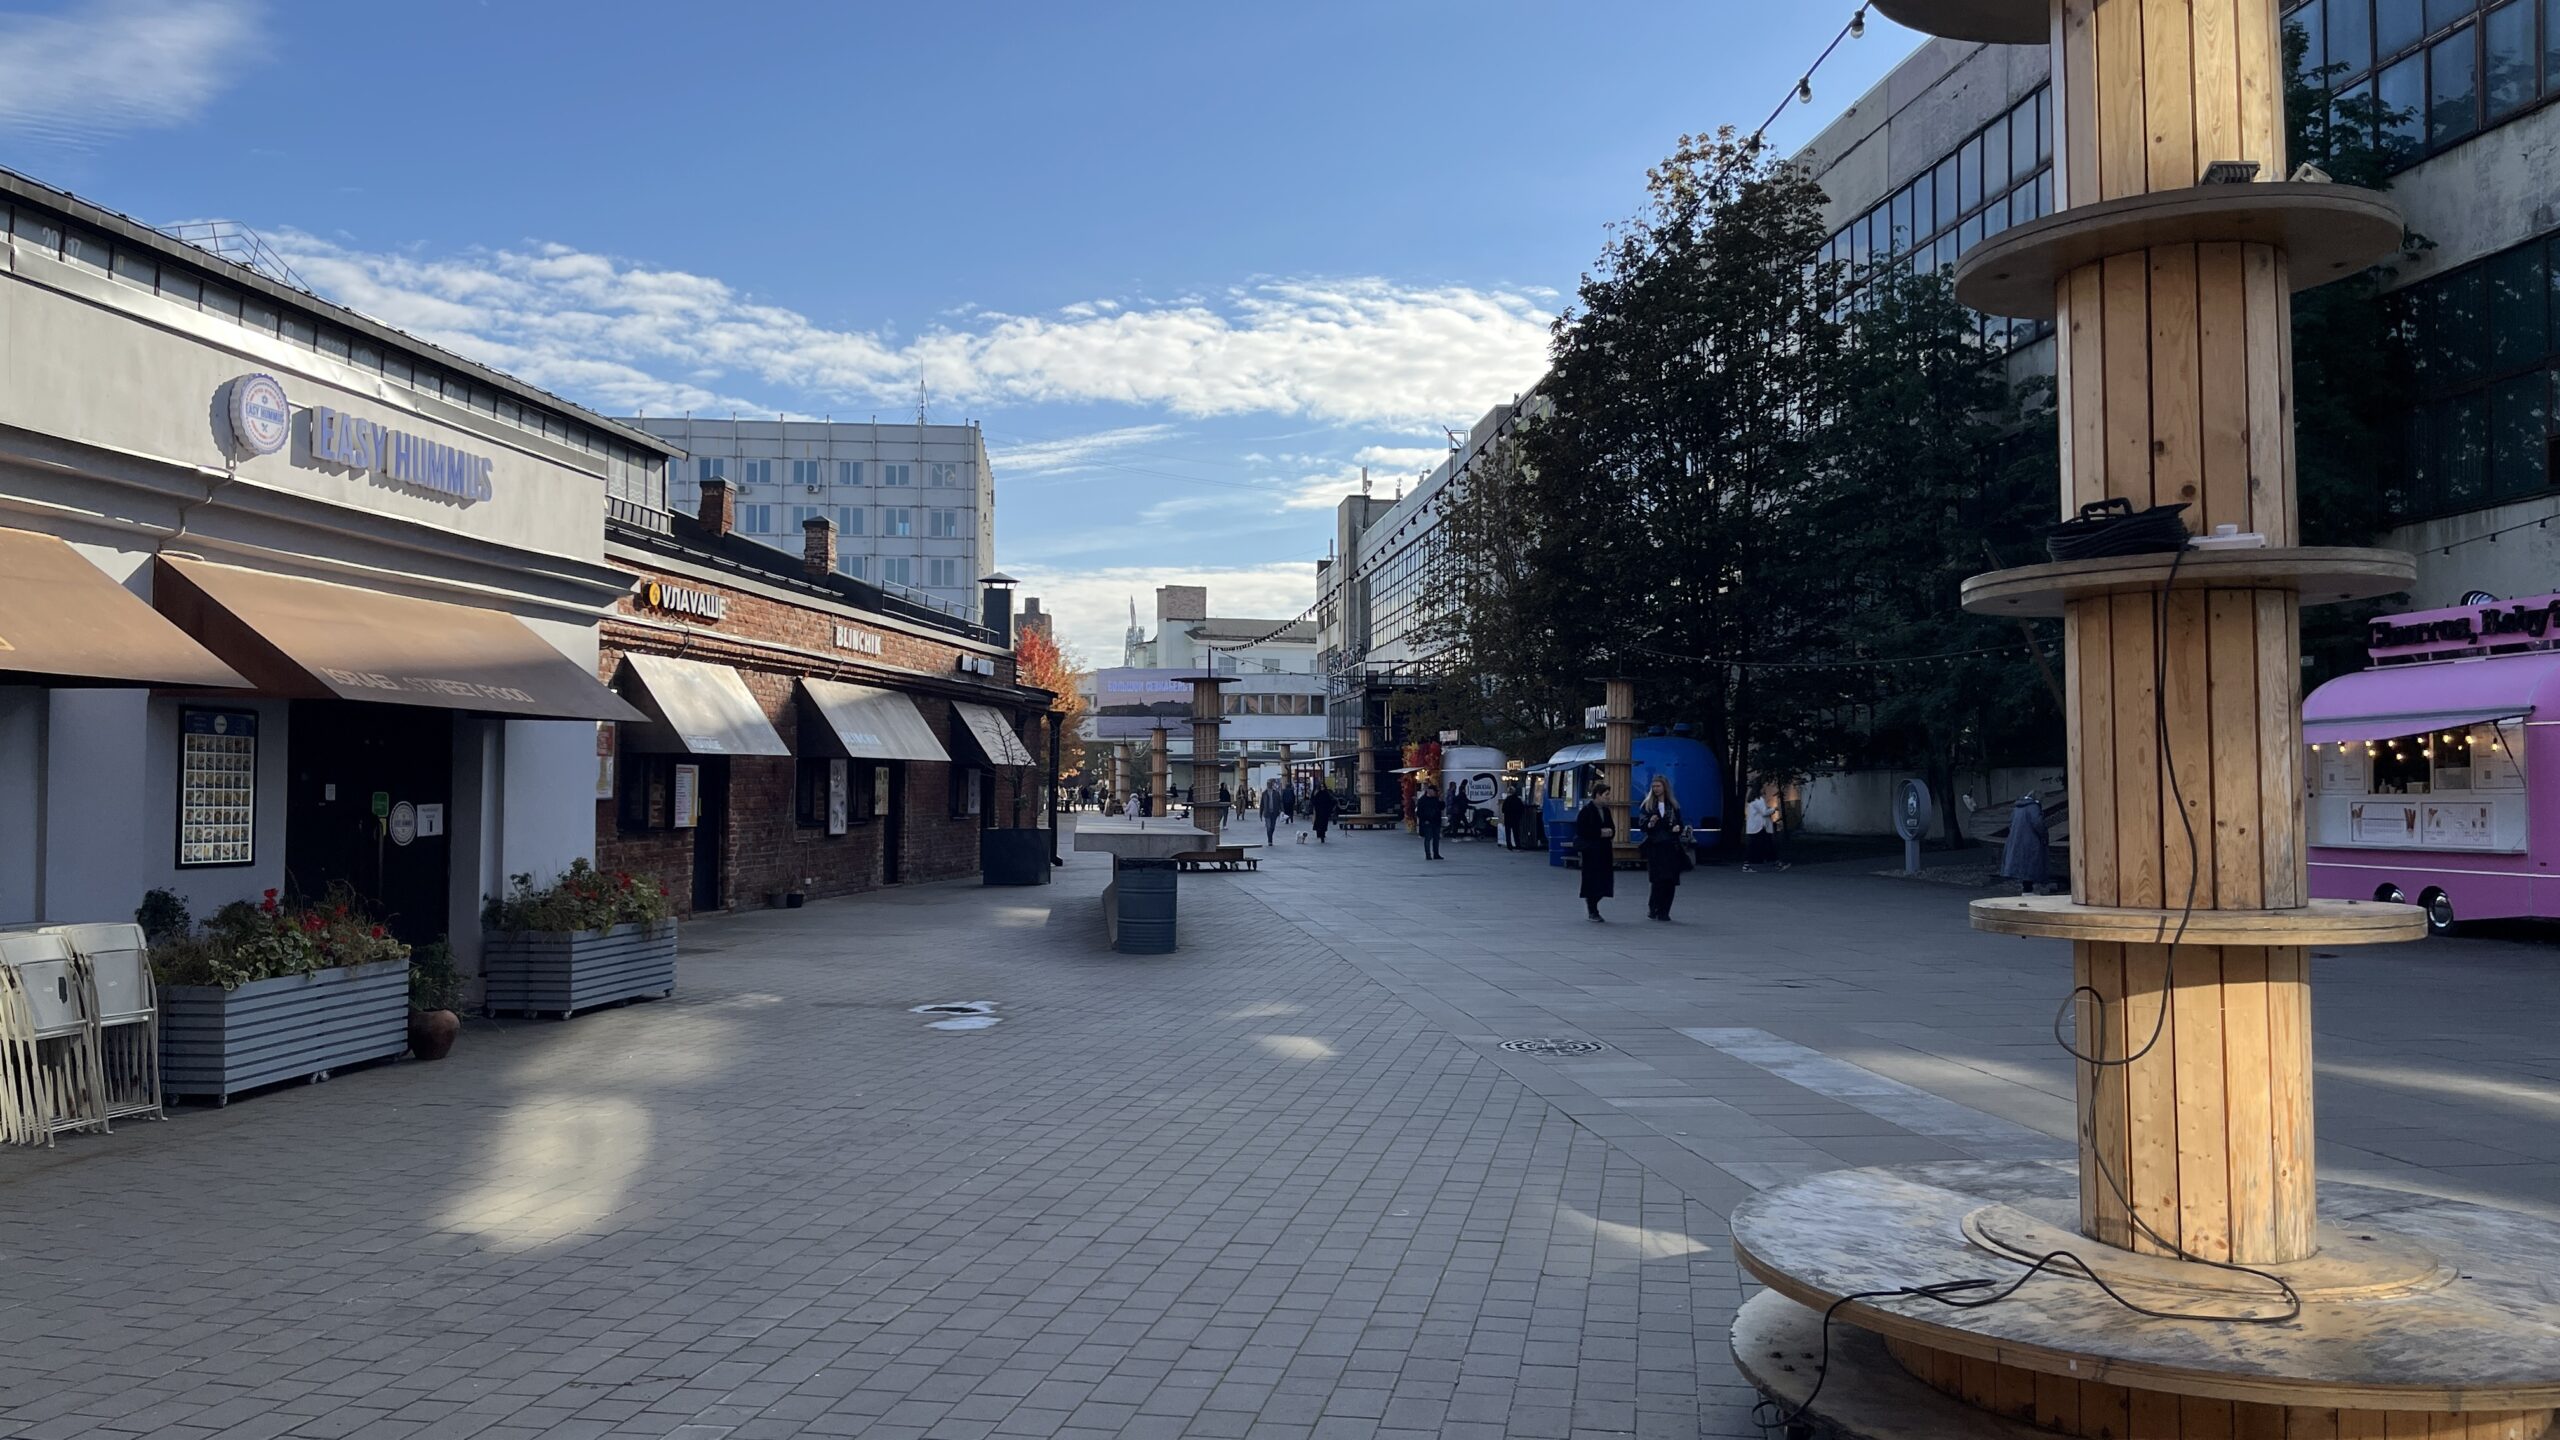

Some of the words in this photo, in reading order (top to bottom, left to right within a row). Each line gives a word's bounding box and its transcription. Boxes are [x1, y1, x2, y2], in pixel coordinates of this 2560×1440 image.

[313, 406, 389, 472] EASY
[387, 430, 493, 502] HUMMUS
[836, 625, 882, 656] BLINCHIK
[319, 667, 409, 691] ISRAEL
[402, 677, 483, 698] STREET
[474, 684, 536, 703] FOOD
